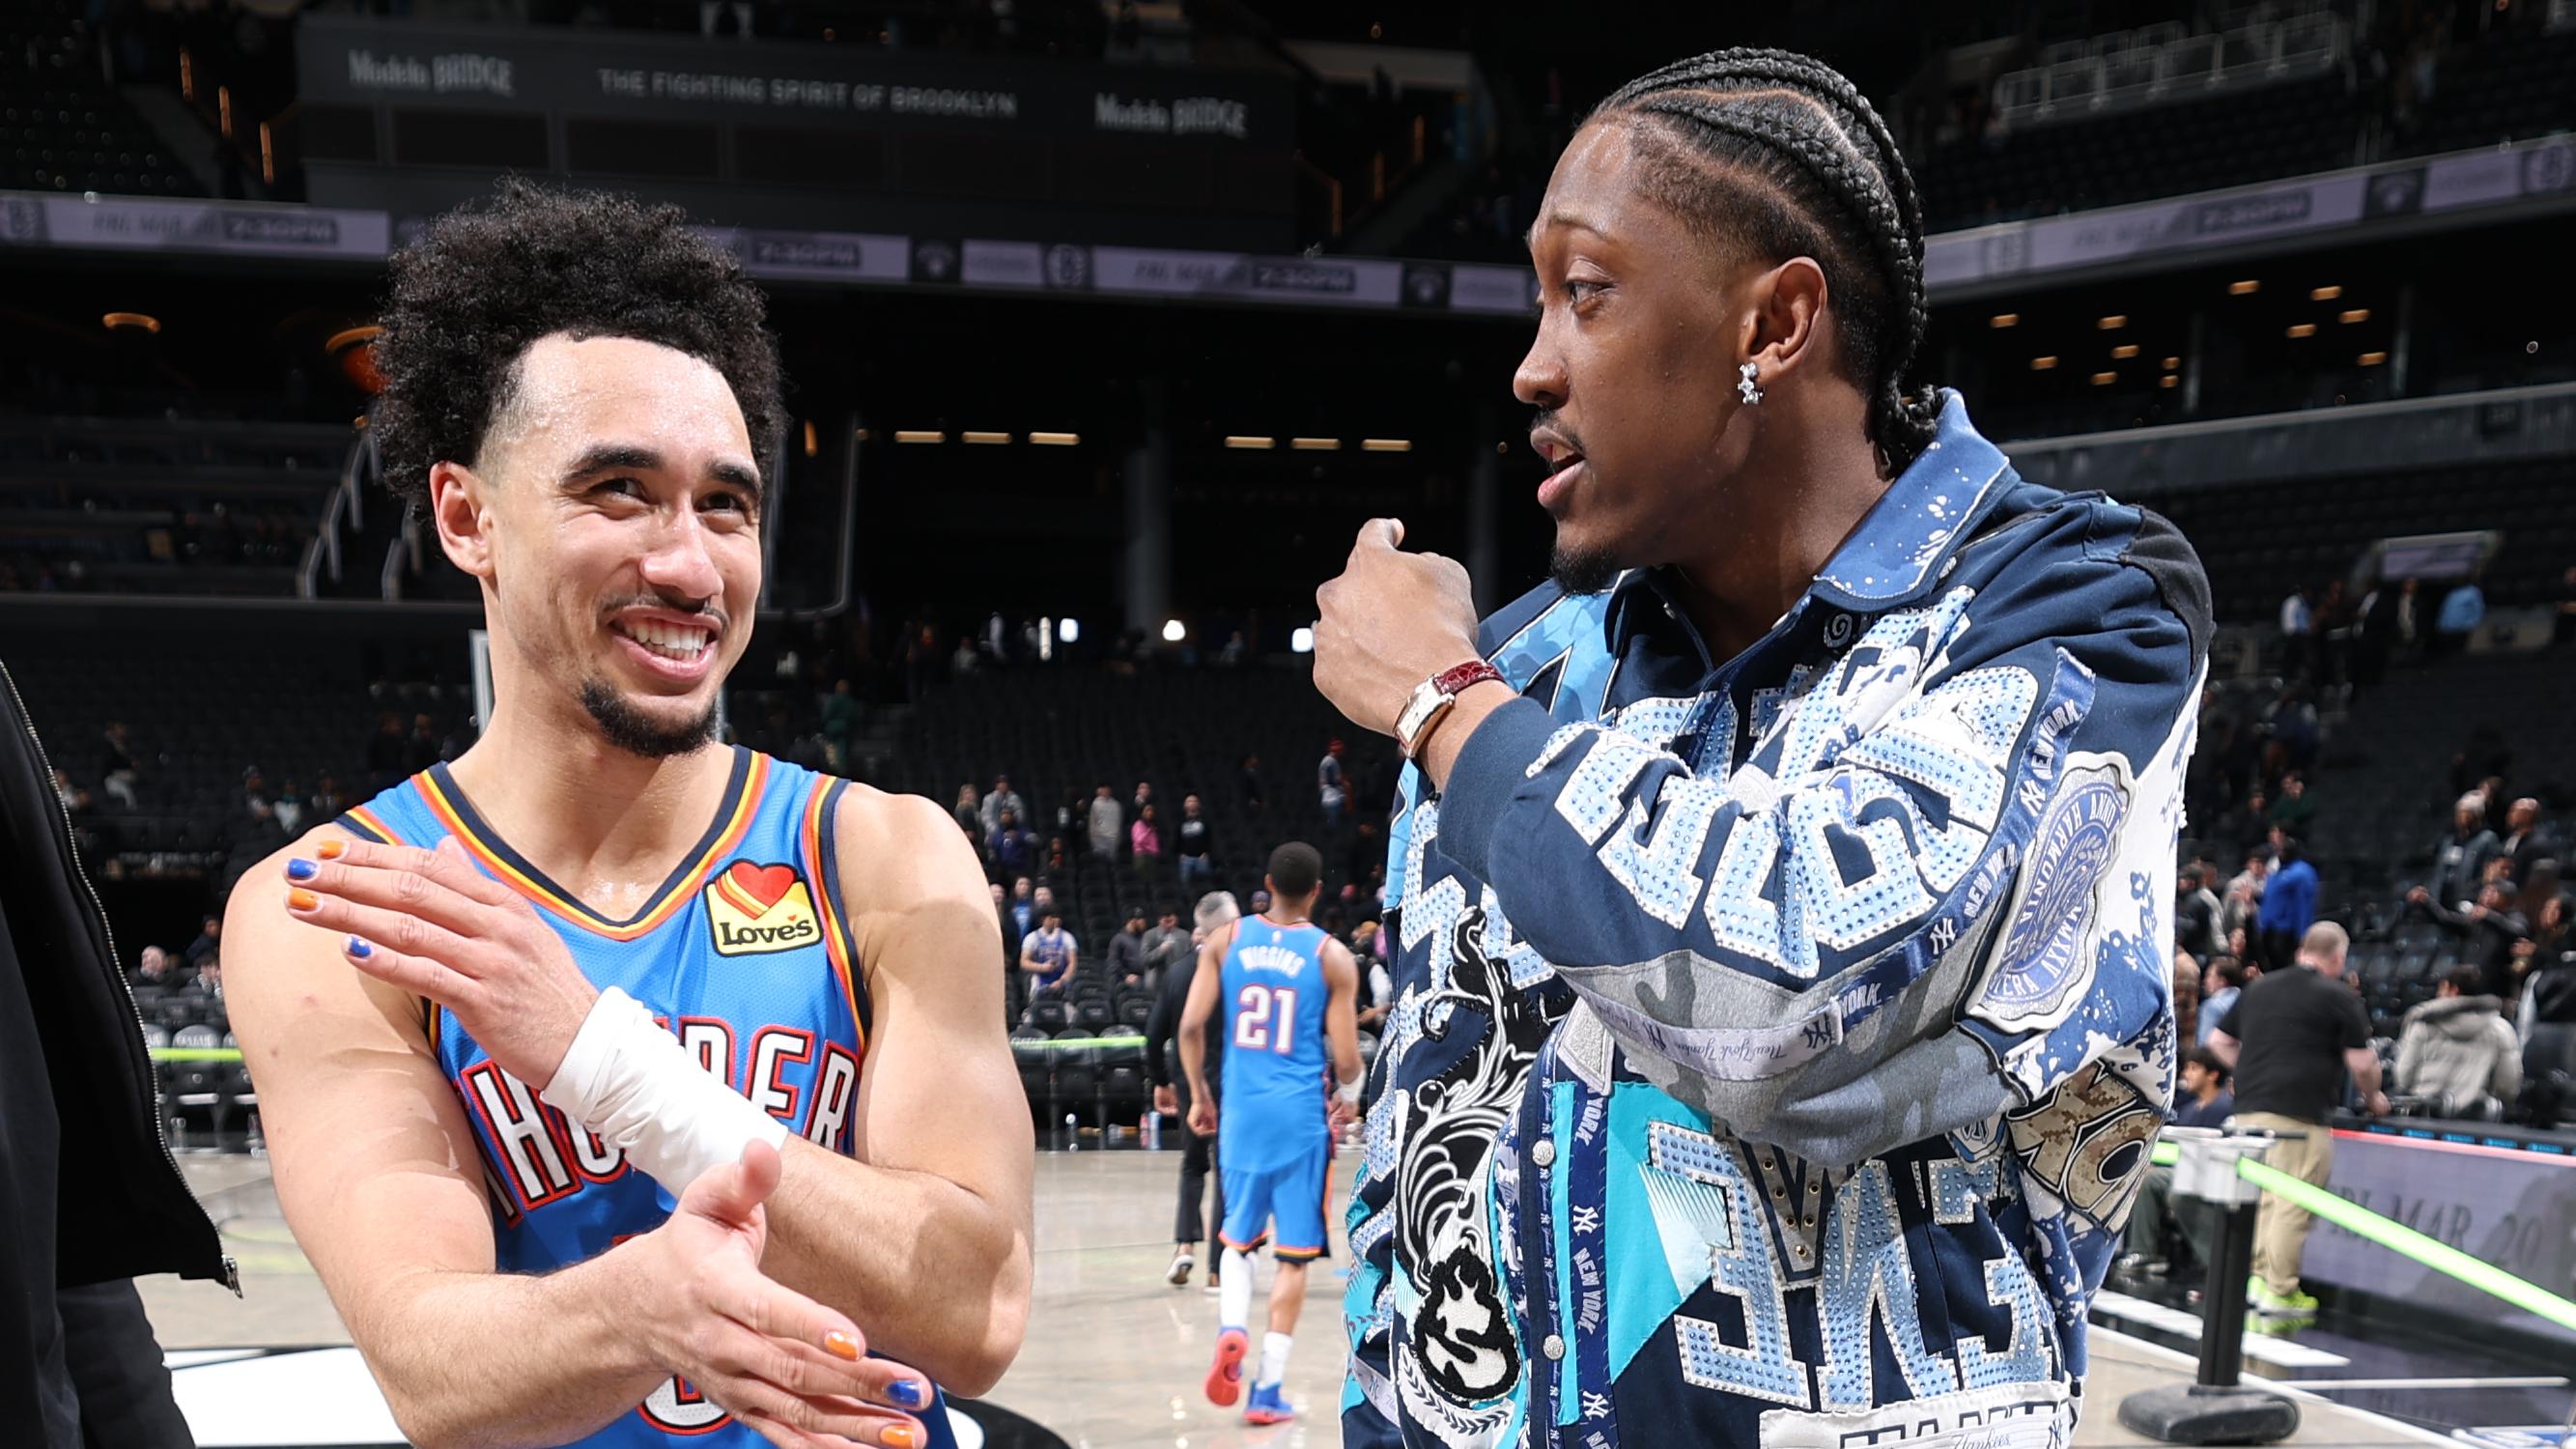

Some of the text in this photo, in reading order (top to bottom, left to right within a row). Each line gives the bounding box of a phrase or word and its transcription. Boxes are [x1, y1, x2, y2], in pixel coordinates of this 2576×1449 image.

[597, 68, 1019, 120] THE FIGHTING SPIRIT OF BROOKLYN
[1238, 946, 1307, 979] WIGGINS
[1234, 983, 1296, 1054] 21
[1719, 1037, 1754, 1061] York
[1573, 1247, 1602, 1335] NEW YORK
